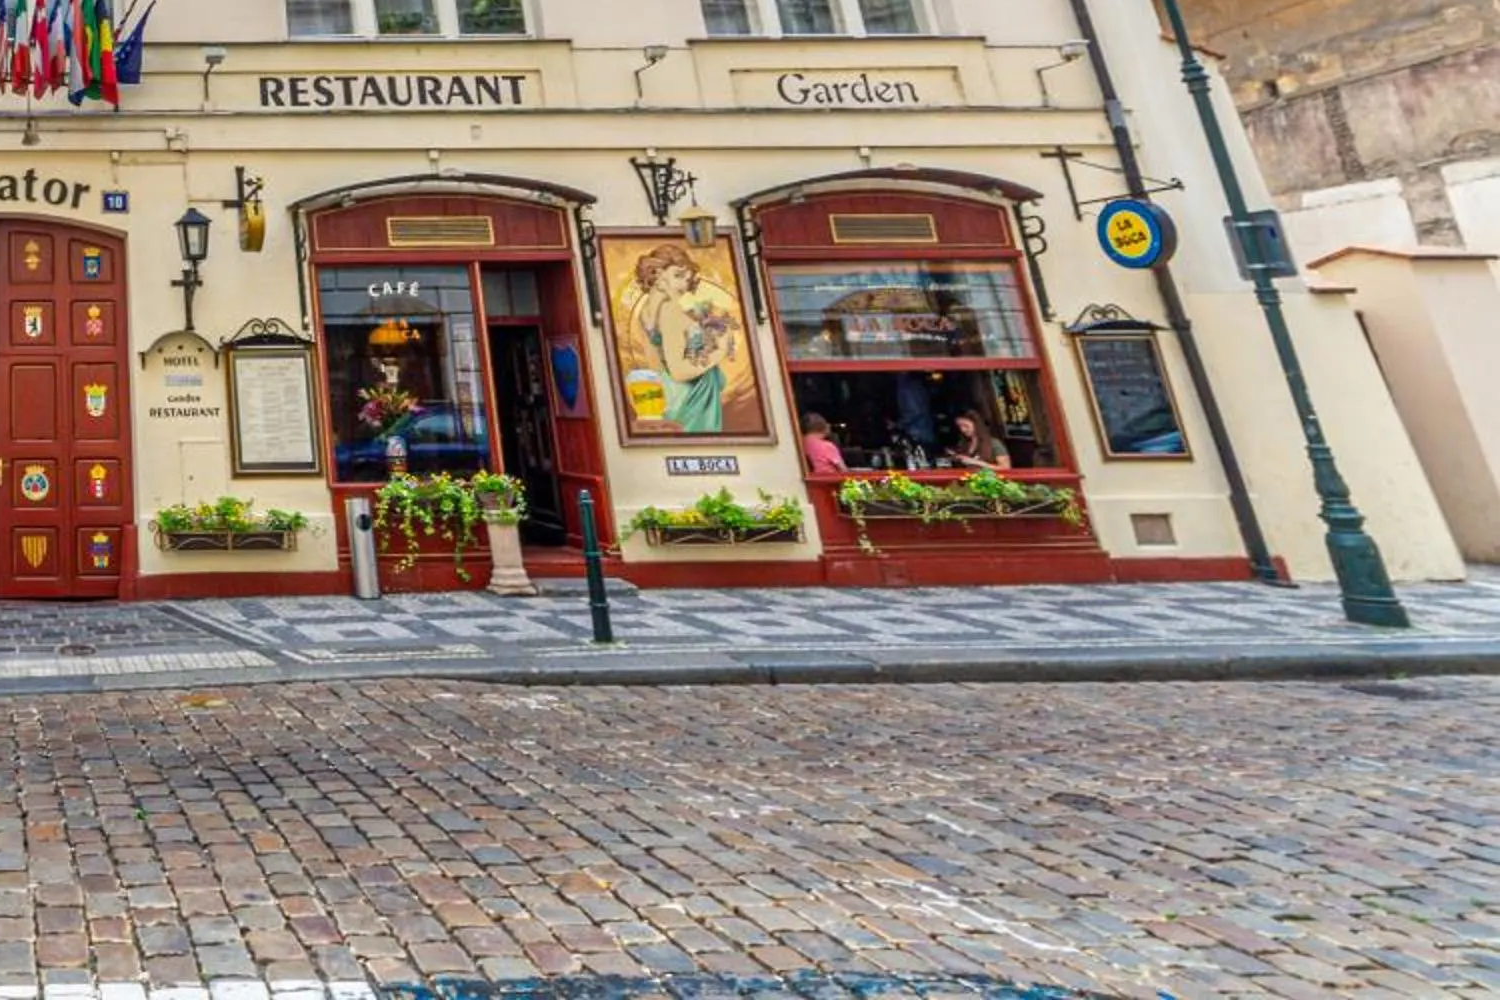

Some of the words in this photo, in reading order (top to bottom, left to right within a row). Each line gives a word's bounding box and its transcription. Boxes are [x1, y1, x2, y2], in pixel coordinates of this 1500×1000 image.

[259, 75, 526, 106] RESTAURANT
[777, 73, 919, 105] Garden
[368, 281, 420, 297] CAFÉ
[149, 407, 220, 418] RESTAURANT
